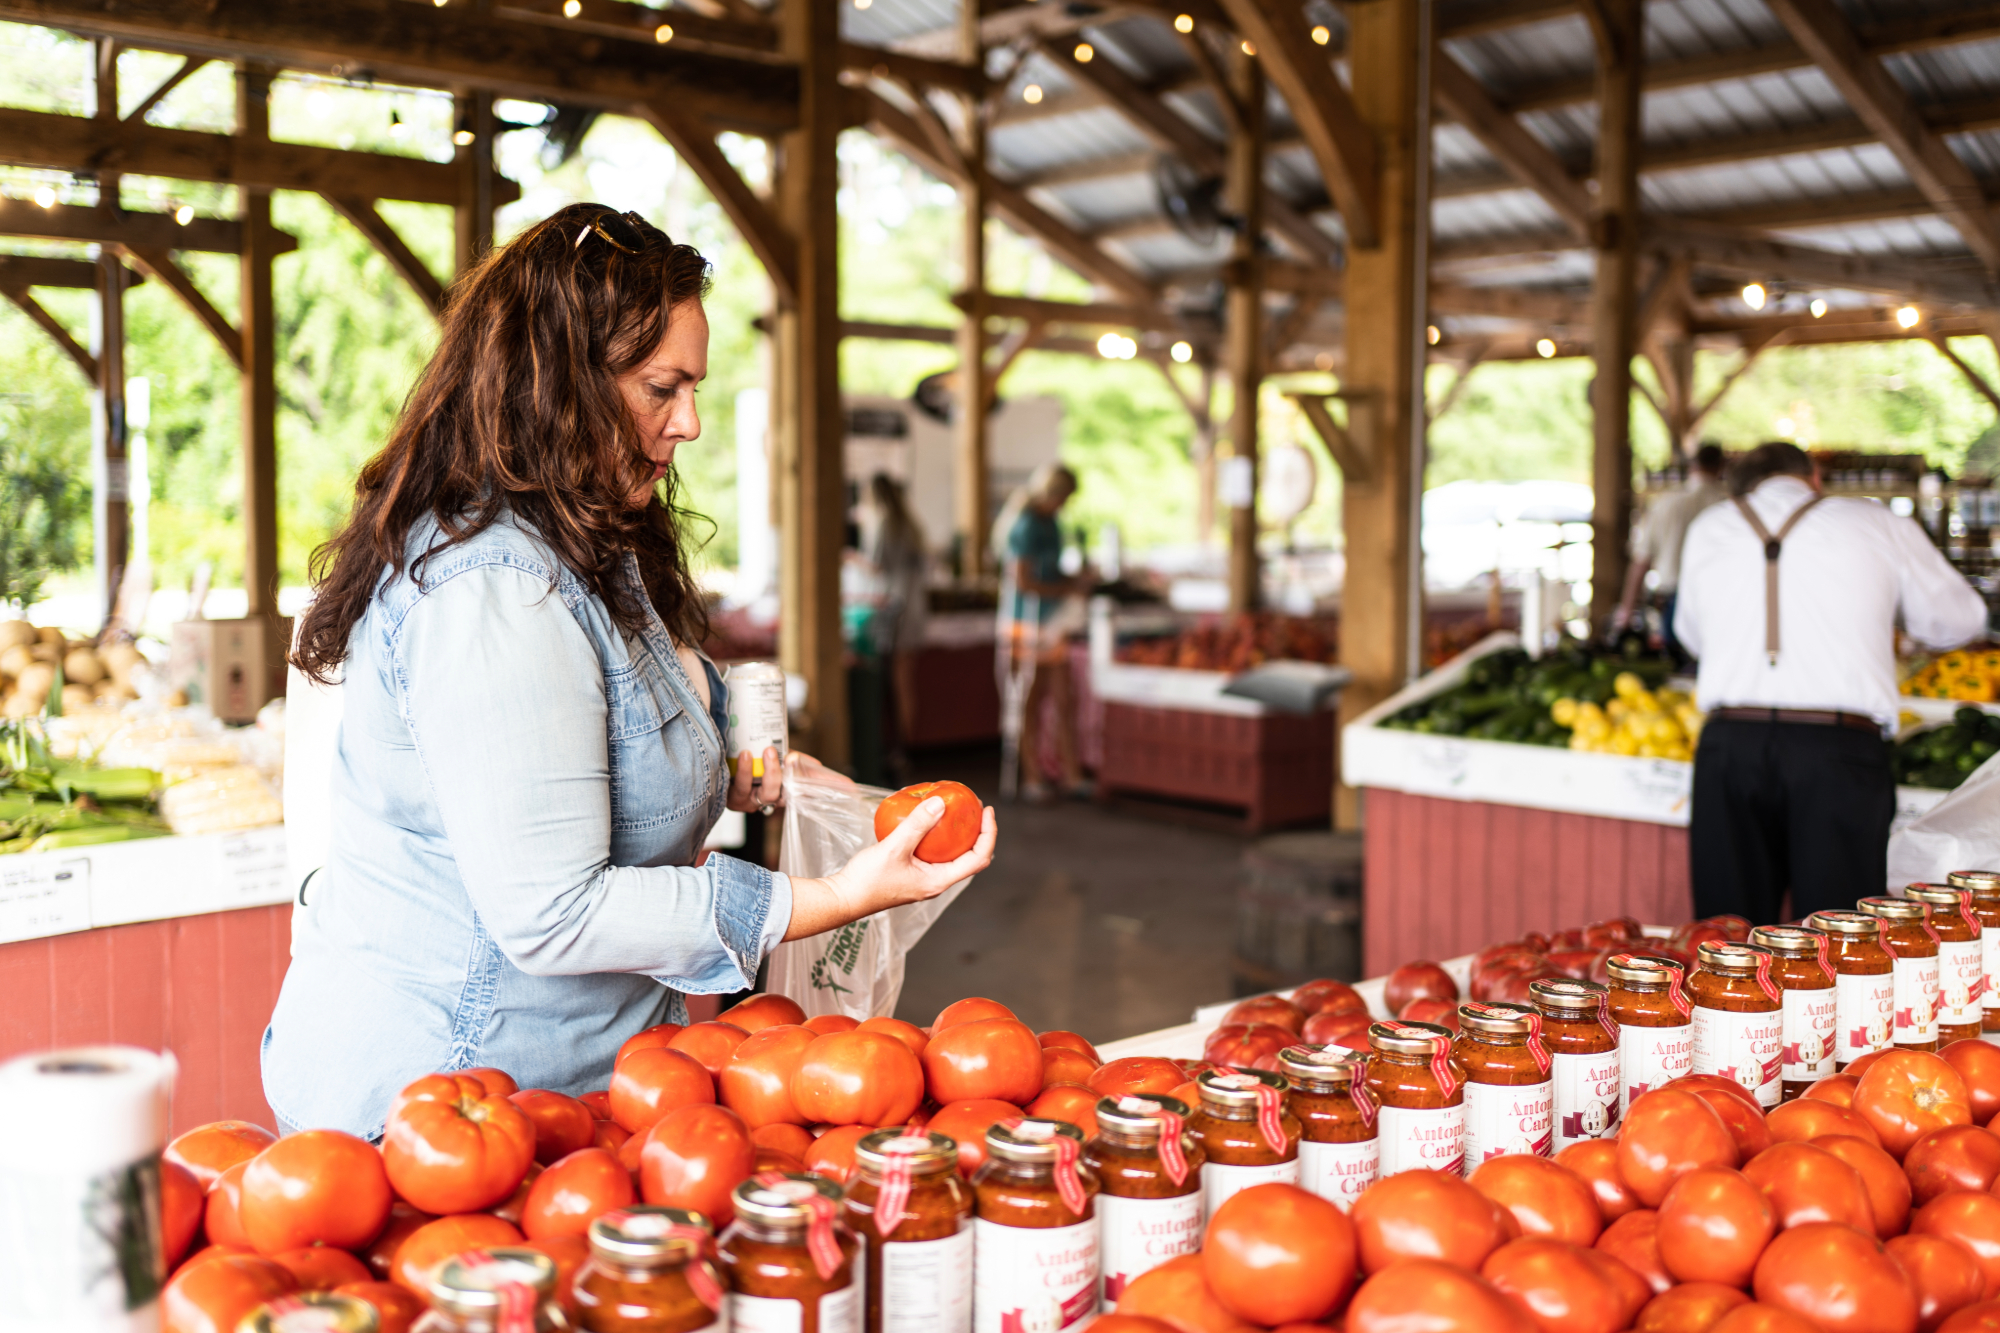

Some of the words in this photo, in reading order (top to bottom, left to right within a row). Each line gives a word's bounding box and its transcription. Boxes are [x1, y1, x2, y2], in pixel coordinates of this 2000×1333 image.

[1407, 1117, 1466, 1141] Antoni
[1419, 1137, 1464, 1159] Carlo
[1144, 1231, 1200, 1256] Carlo
